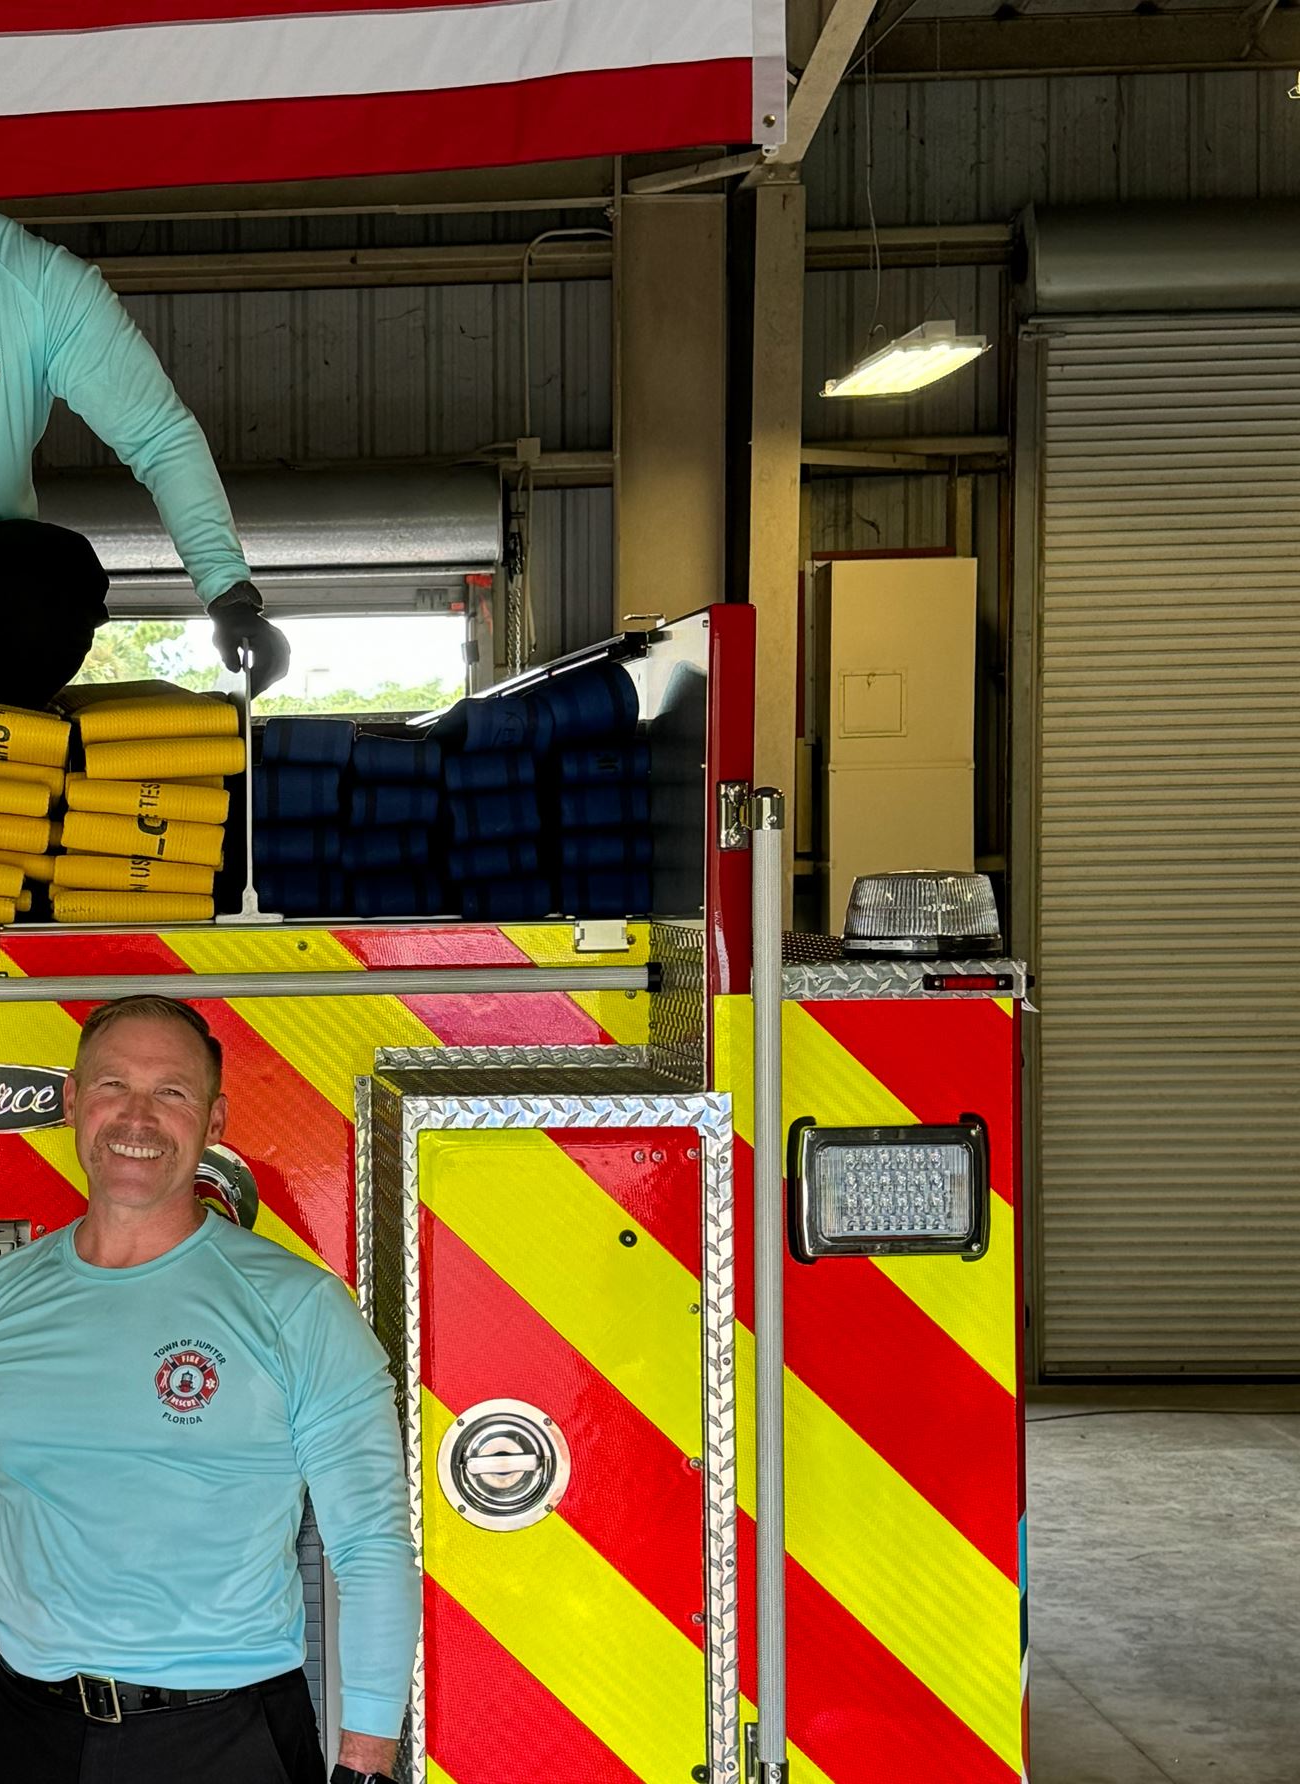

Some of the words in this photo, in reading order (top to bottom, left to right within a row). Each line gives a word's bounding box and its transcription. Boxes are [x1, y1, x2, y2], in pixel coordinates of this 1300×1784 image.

[153, 1341, 179, 1359] TOWN
[180, 1339, 192, 1347] OF
[194, 1340, 227, 1366] JUPITER
[181, 1355, 200, 1364] FIRE
[170, 1397, 197, 1407] RESCUE
[162, 1412, 203, 1425] FLORIDA
